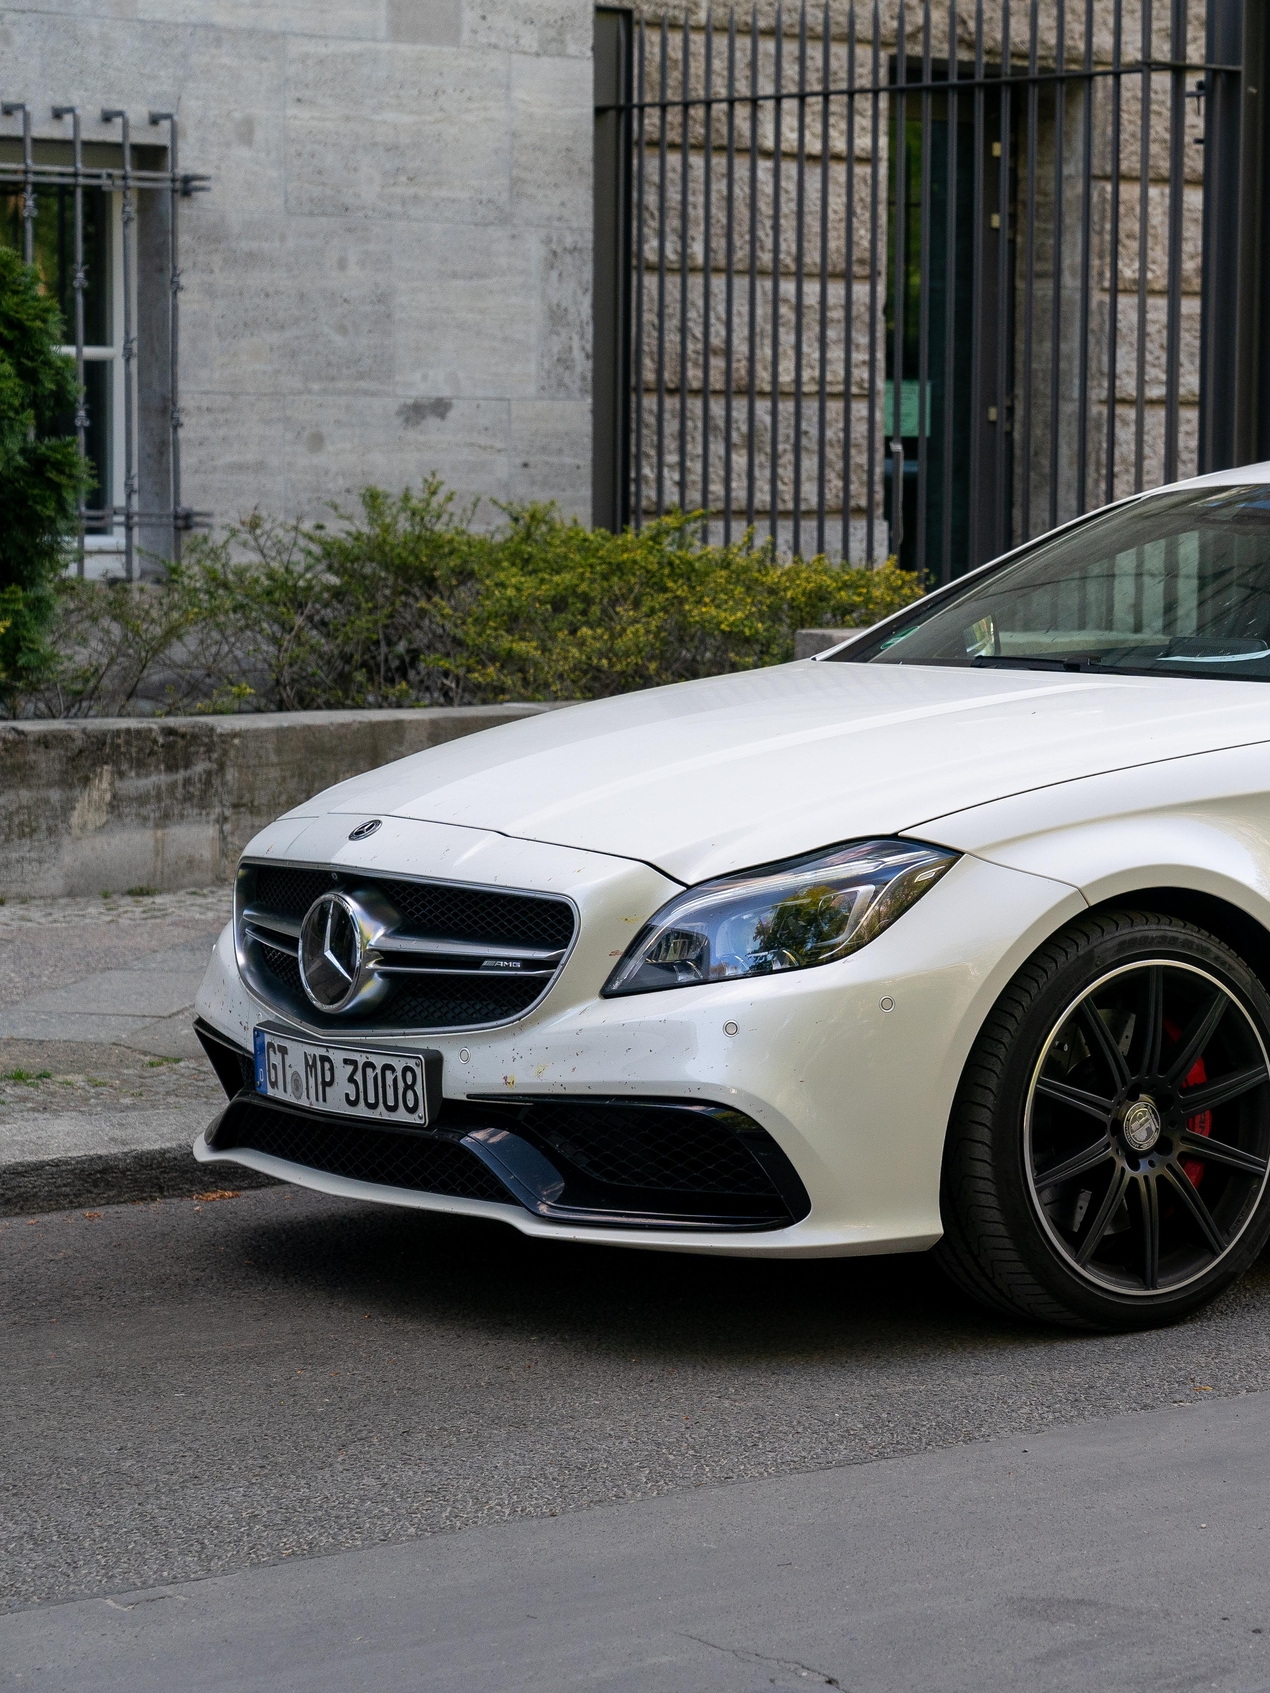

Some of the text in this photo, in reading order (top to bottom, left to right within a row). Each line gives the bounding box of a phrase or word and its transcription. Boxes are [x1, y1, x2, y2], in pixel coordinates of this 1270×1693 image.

[266, 1041, 288, 1093] GT
[303, 1050, 335, 1103] MP
[342, 1057, 419, 1115] 3008
